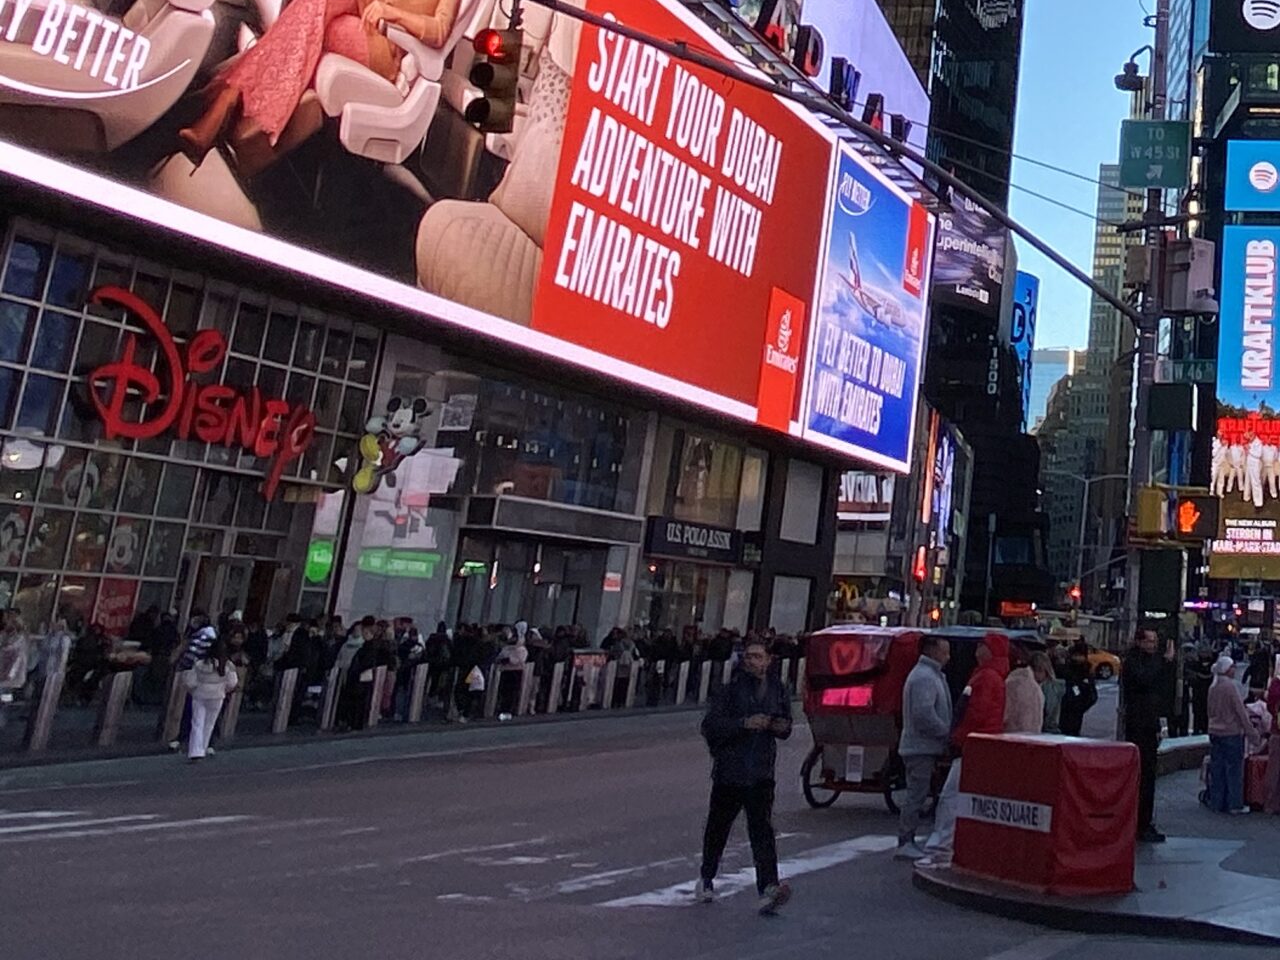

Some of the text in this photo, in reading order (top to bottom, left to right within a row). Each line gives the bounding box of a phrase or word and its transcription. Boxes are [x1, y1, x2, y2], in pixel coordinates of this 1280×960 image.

[588, 12, 783, 205] START YOUR DUBAI
[1147, 127, 1165, 141] TO
[1144, 145, 1164, 160] 45
[570, 107, 762, 278] ADVENTURE WITH
[554, 201, 681, 329] EMIRATES
[1241, 240, 1275, 388] KRAFTKLUB
[765, 344, 798, 374] Emirates
[822, 323, 907, 399] FLY BETTER TO DUBAI
[987, 346, 998, 394] 1500
[816, 370, 883, 436] WITH EMIRATES
[971, 797, 1039, 826] TIMES SQUARE
